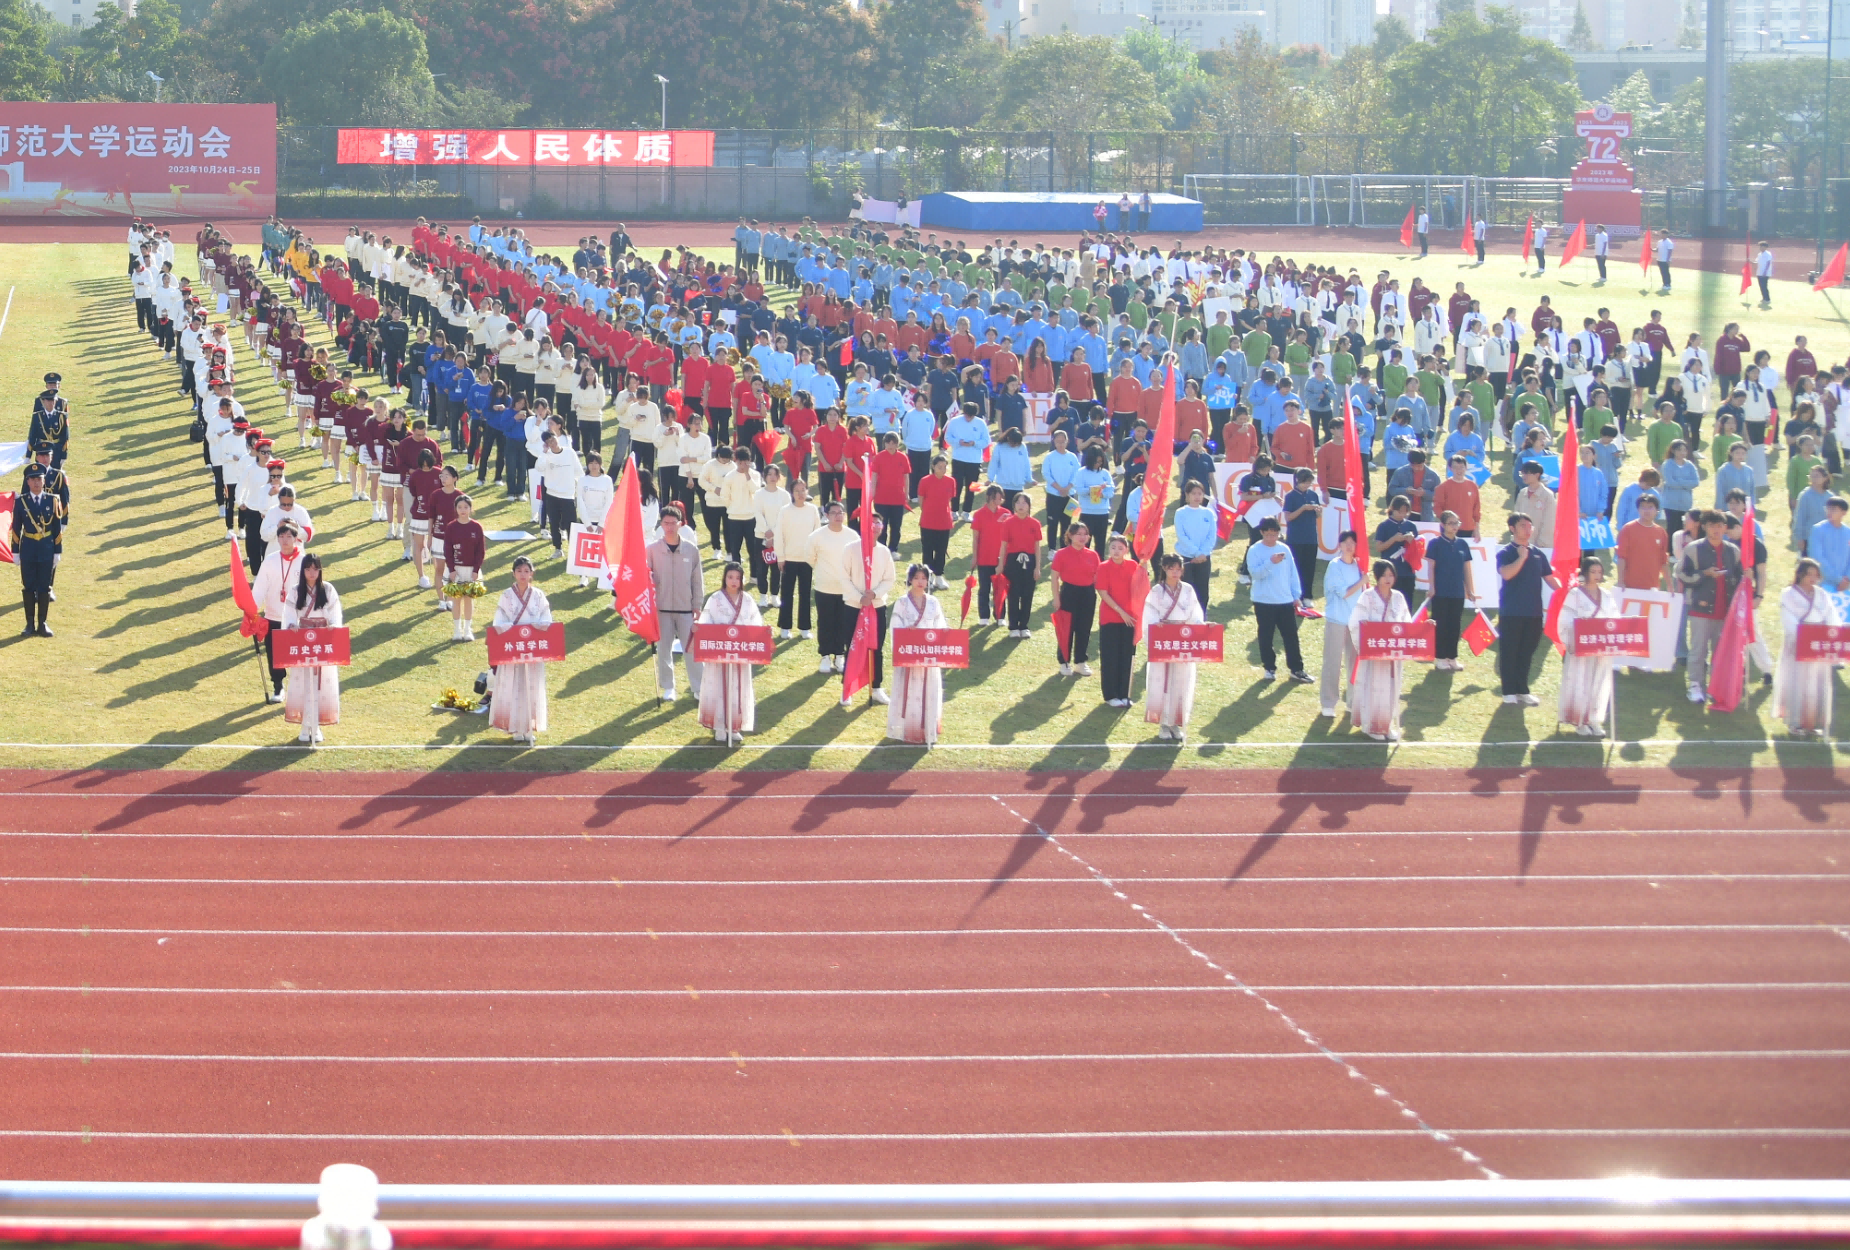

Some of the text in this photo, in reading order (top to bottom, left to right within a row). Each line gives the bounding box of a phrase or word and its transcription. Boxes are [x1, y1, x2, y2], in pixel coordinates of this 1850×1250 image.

[380, 132, 673, 162] 增强人民体质
[1588, 136, 1616, 159] 72
[1367, 638, 1428, 649] 社会发展学院
[1579, 633, 1643, 645] 经济与管理学院
[289, 643, 334, 655] 历史学系
[504, 639, 548, 652] 外语学院
[699, 640, 765, 652] 国际汉语文化学院
[898, 645, 962, 656] 心理与认知科学学院
[1154, 640, 1218, 651] 马克思主义学院
